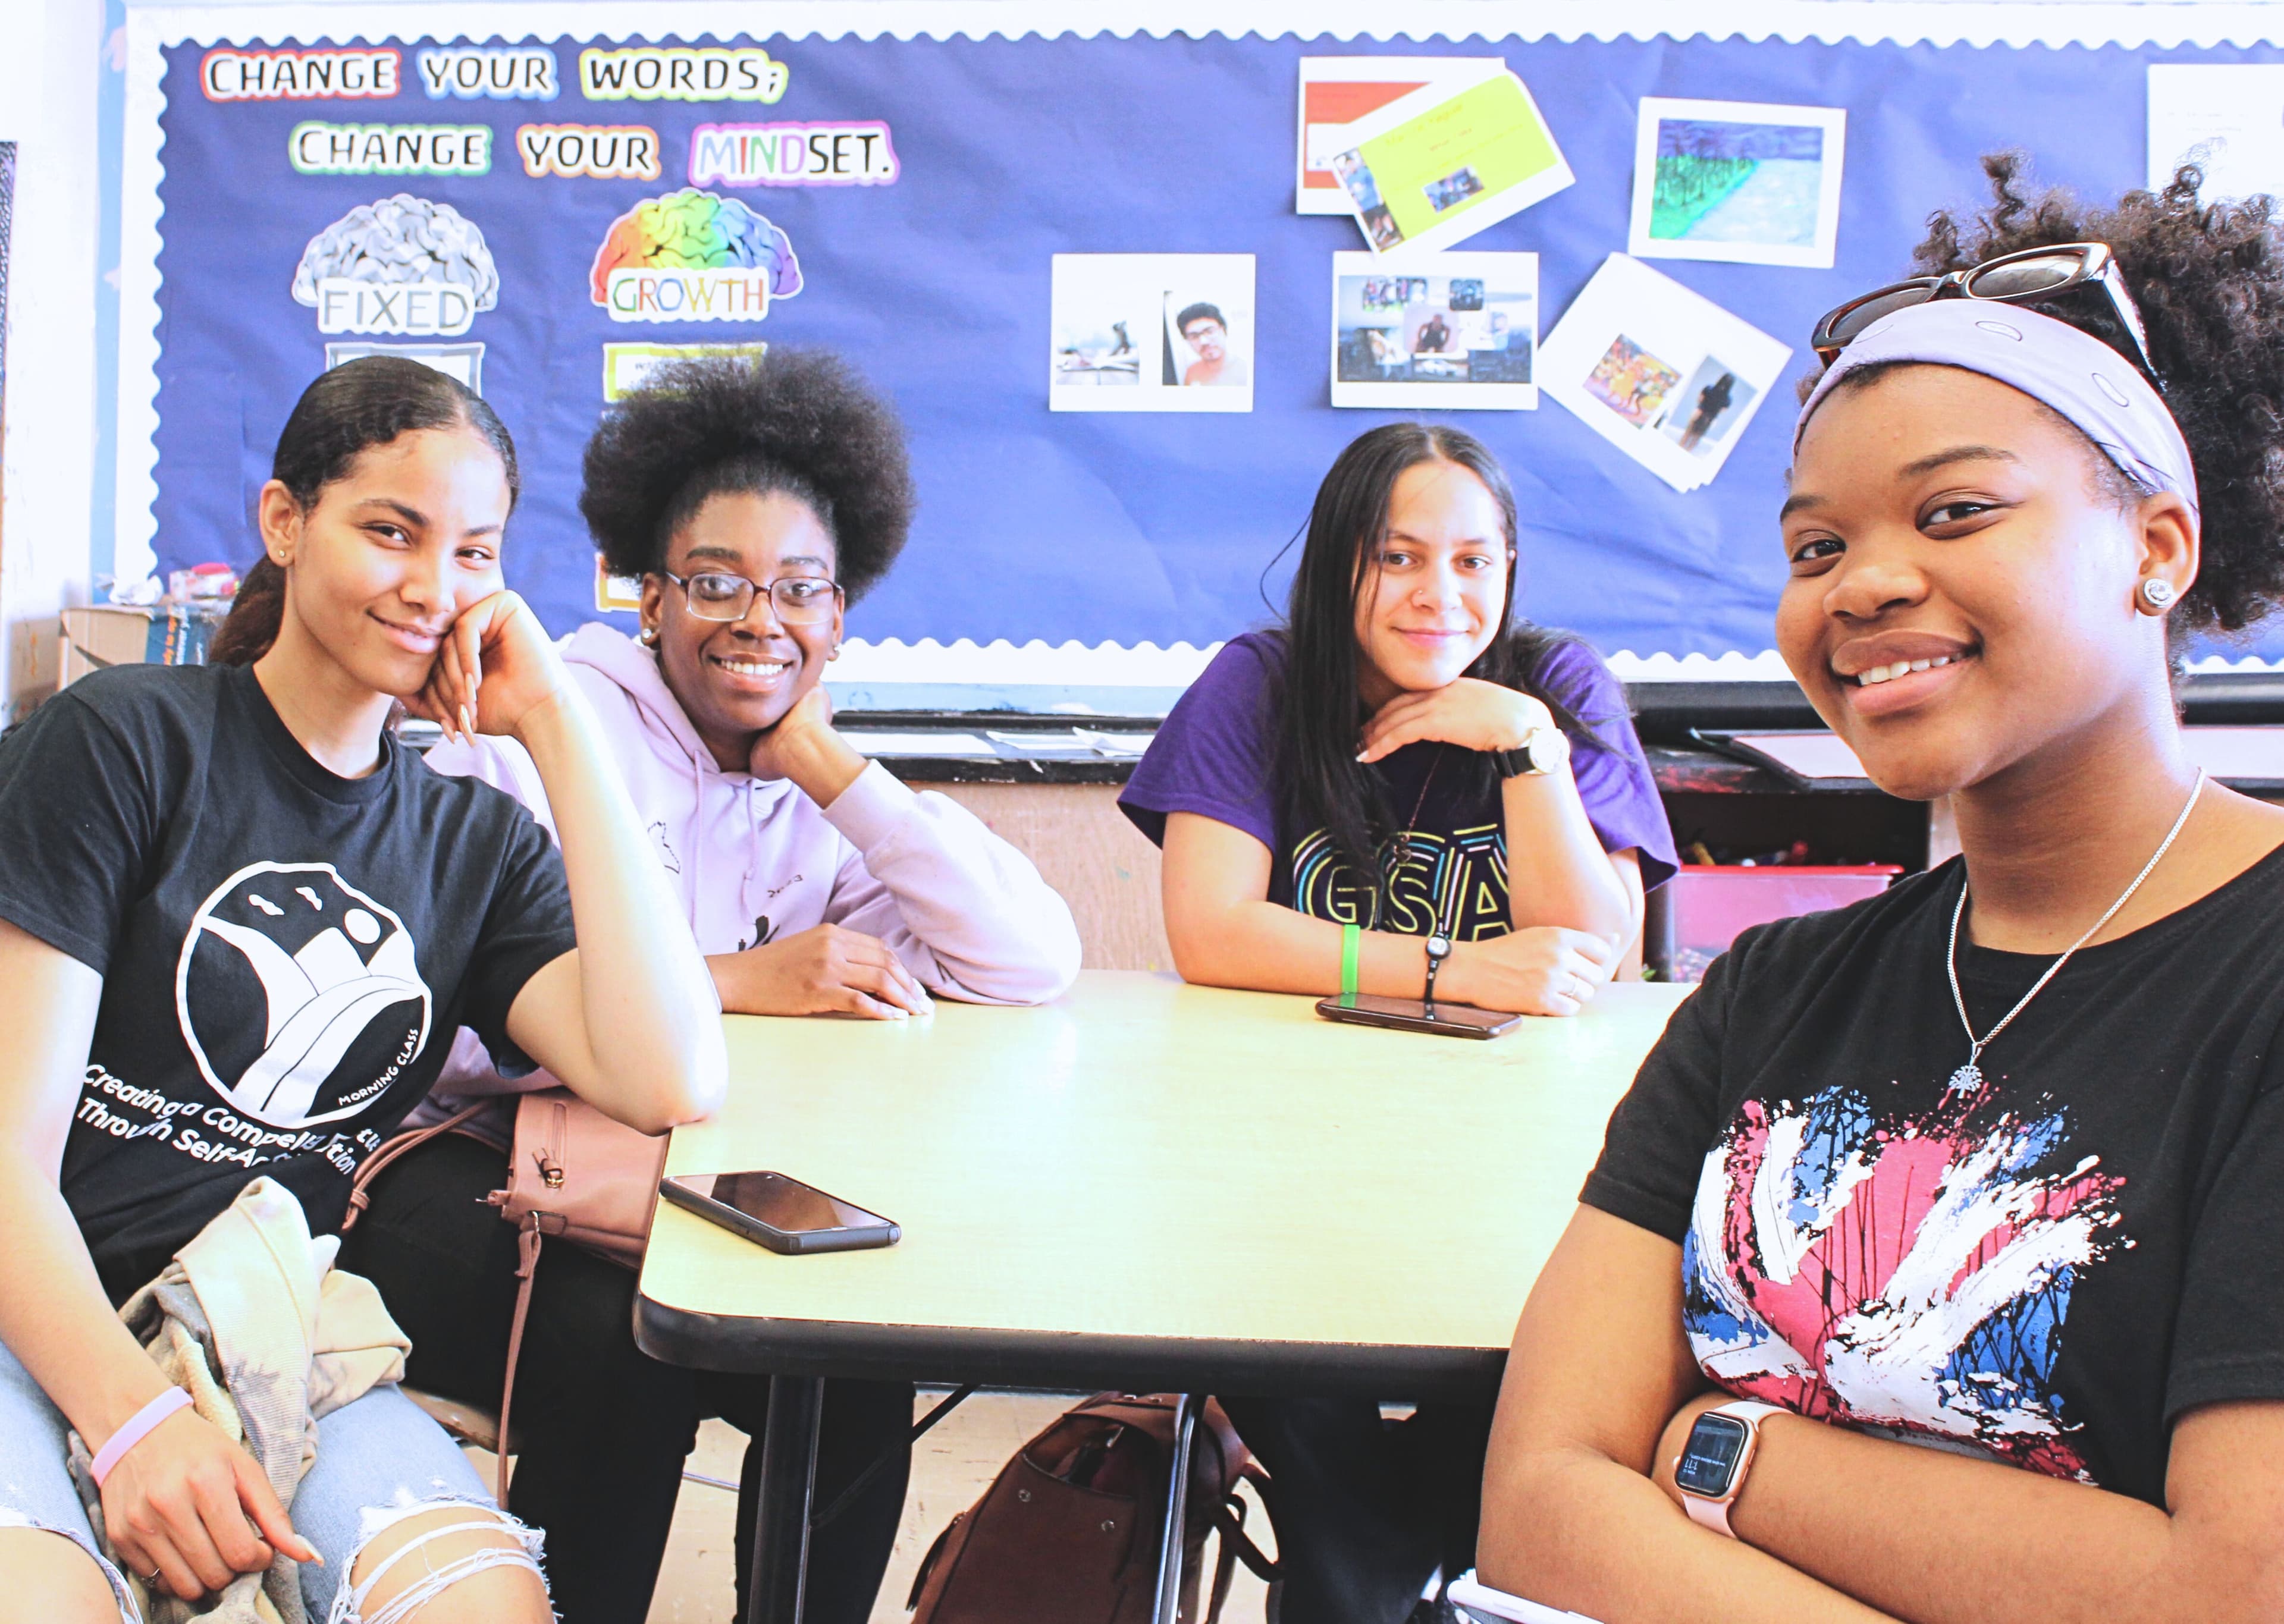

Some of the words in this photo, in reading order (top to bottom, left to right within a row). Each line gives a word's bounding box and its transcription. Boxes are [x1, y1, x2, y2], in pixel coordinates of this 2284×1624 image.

[208, 56, 398, 94] CHANGE
[424, 55, 550, 90] YOUR
[589, 57, 779, 94] WORDS;
[297, 129, 487, 166] CHANGE
[526, 134, 650, 171] YOUR
[699, 133, 890, 175] MINDSET.
[322, 288, 470, 330] FIXED
[611, 277, 764, 313] GROWTH
[1292, 823, 1516, 942] GSA
[338, 1066, 399, 1106] MORNING
[396, 1028, 419, 1066] CLASS
[83, 1064, 181, 1120] Creating
